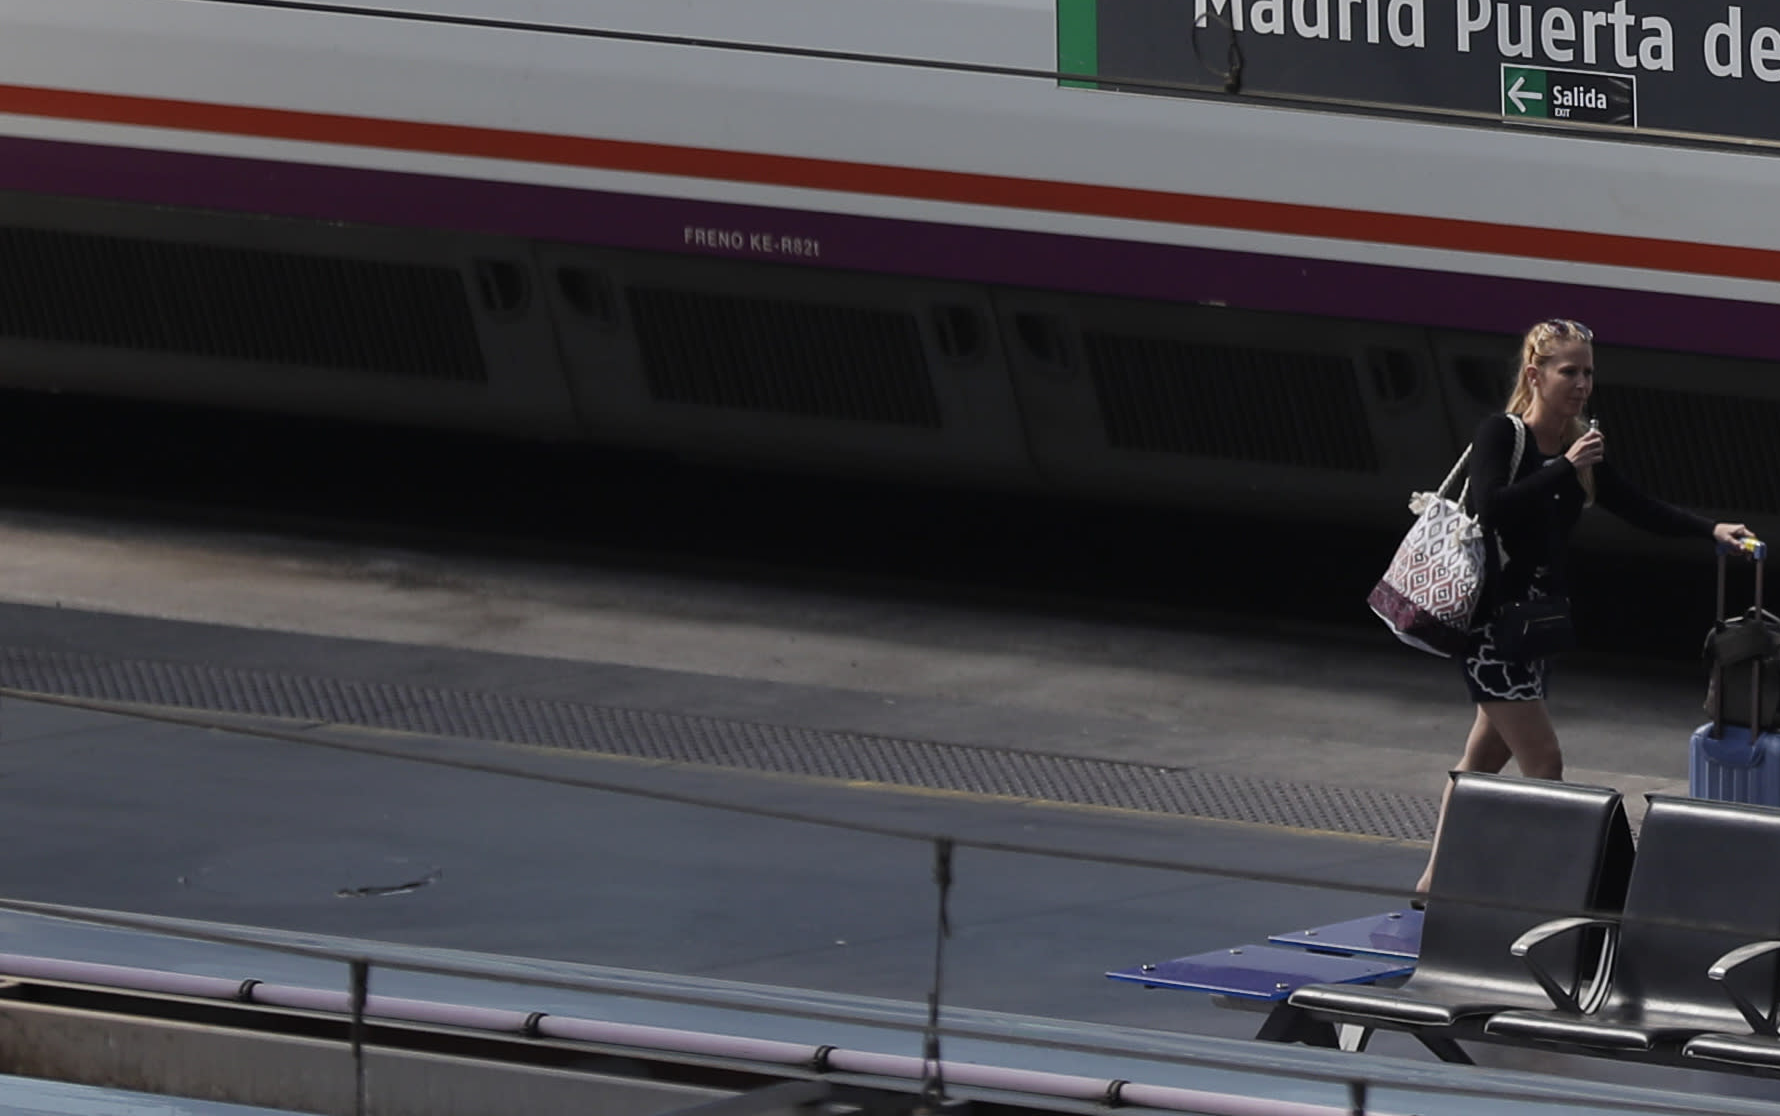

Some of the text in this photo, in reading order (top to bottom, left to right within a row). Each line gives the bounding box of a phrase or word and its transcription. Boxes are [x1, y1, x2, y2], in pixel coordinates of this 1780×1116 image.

[1553, 86, 1607, 109] Salida
[1554, 107, 1571, 118] EXIT
[684, 227, 743, 250] FRENO
